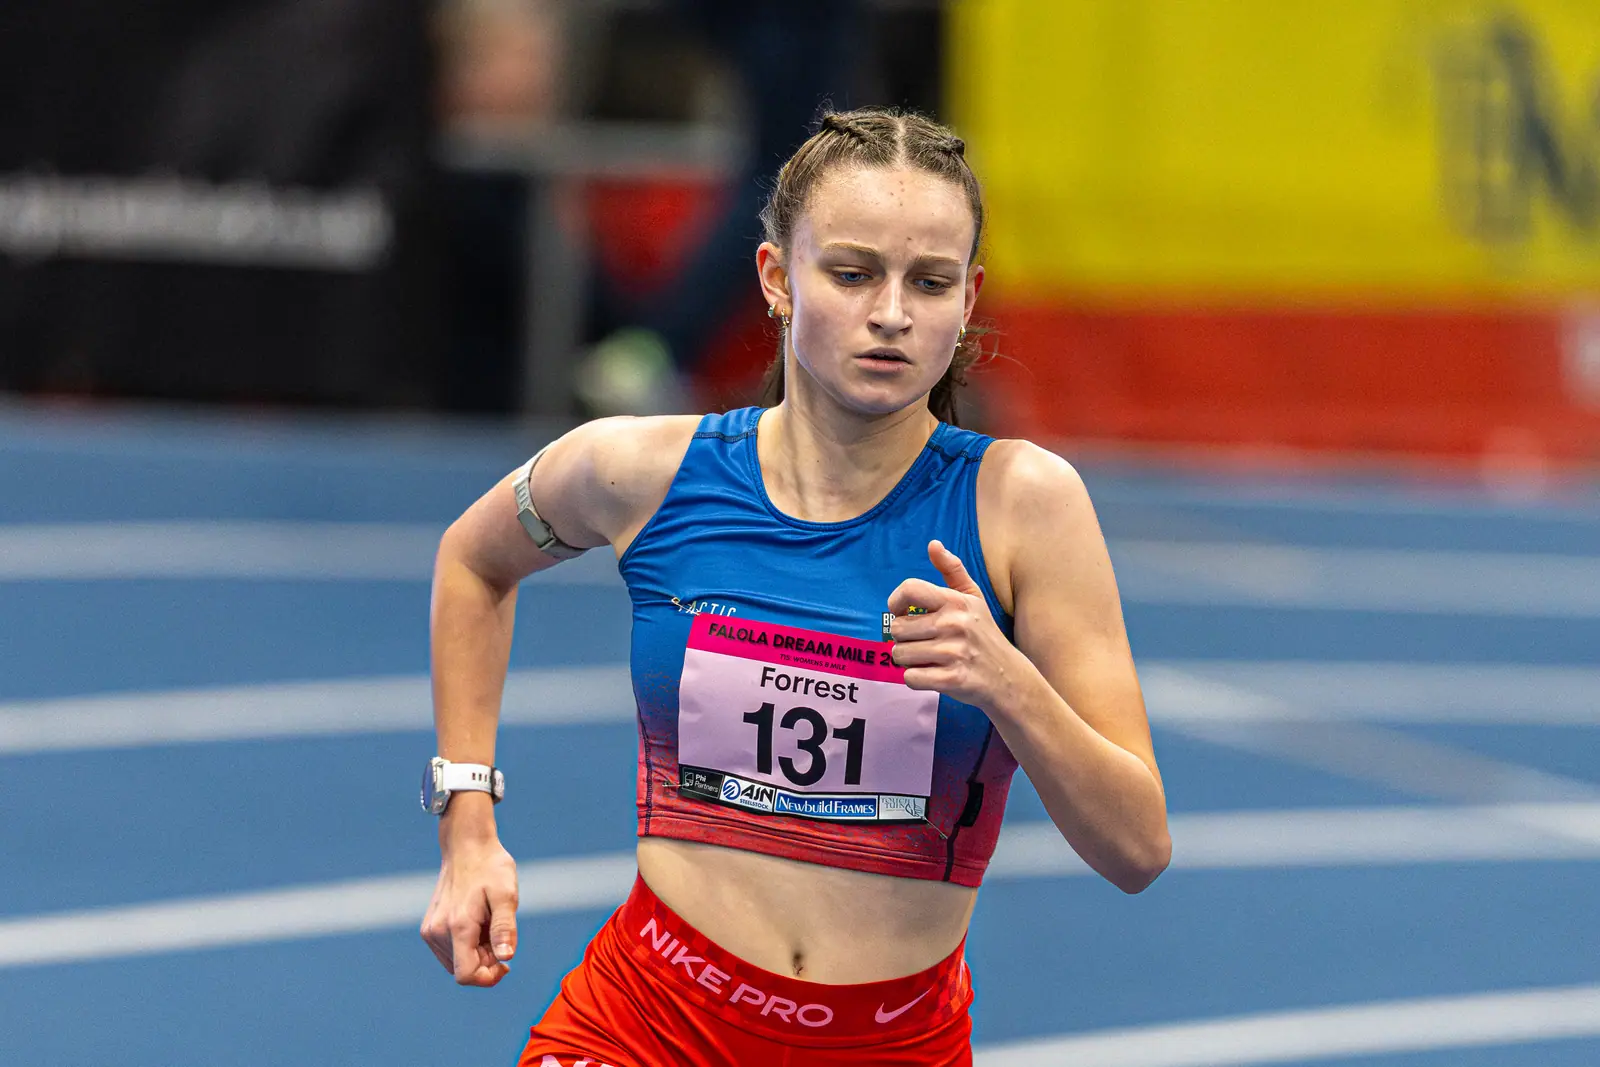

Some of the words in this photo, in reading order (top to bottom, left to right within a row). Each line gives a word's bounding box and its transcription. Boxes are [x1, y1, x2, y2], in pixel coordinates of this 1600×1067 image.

[708, 622, 769, 646] FALOLA
[772, 633, 833, 658] DREAM
[836, 645, 876, 665] MILE
[830, 663, 847, 671] MILE
[760, 666, 859, 704] Forrest
[742, 702, 867, 787] 131
[694, 781, 719, 793] Partners
[695, 773, 707, 783] Phi
[739, 798, 769, 811] STEELSTOCK
[639, 917, 732, 995] NIKE
[729, 983, 834, 1028] PRO
